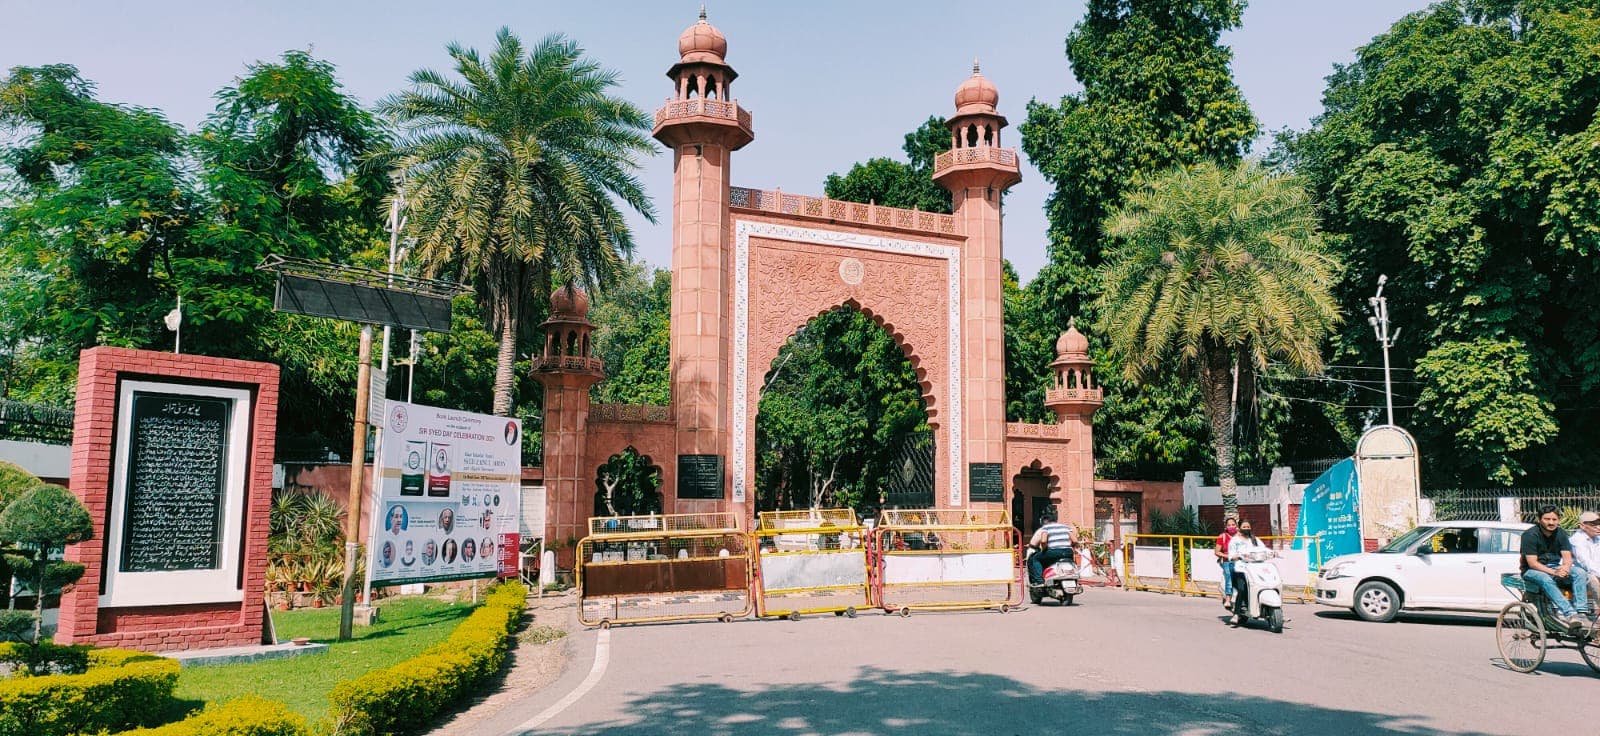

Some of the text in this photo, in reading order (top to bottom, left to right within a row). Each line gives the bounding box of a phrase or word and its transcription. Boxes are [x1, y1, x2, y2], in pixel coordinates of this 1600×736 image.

[447, 414, 462, 422] Launch
[462, 416, 482, 425] Ceremony
[428, 428, 442, 436] SYED
[442, 430, 453, 438] DAY
[453, 431, 485, 441] CELEBRATION
